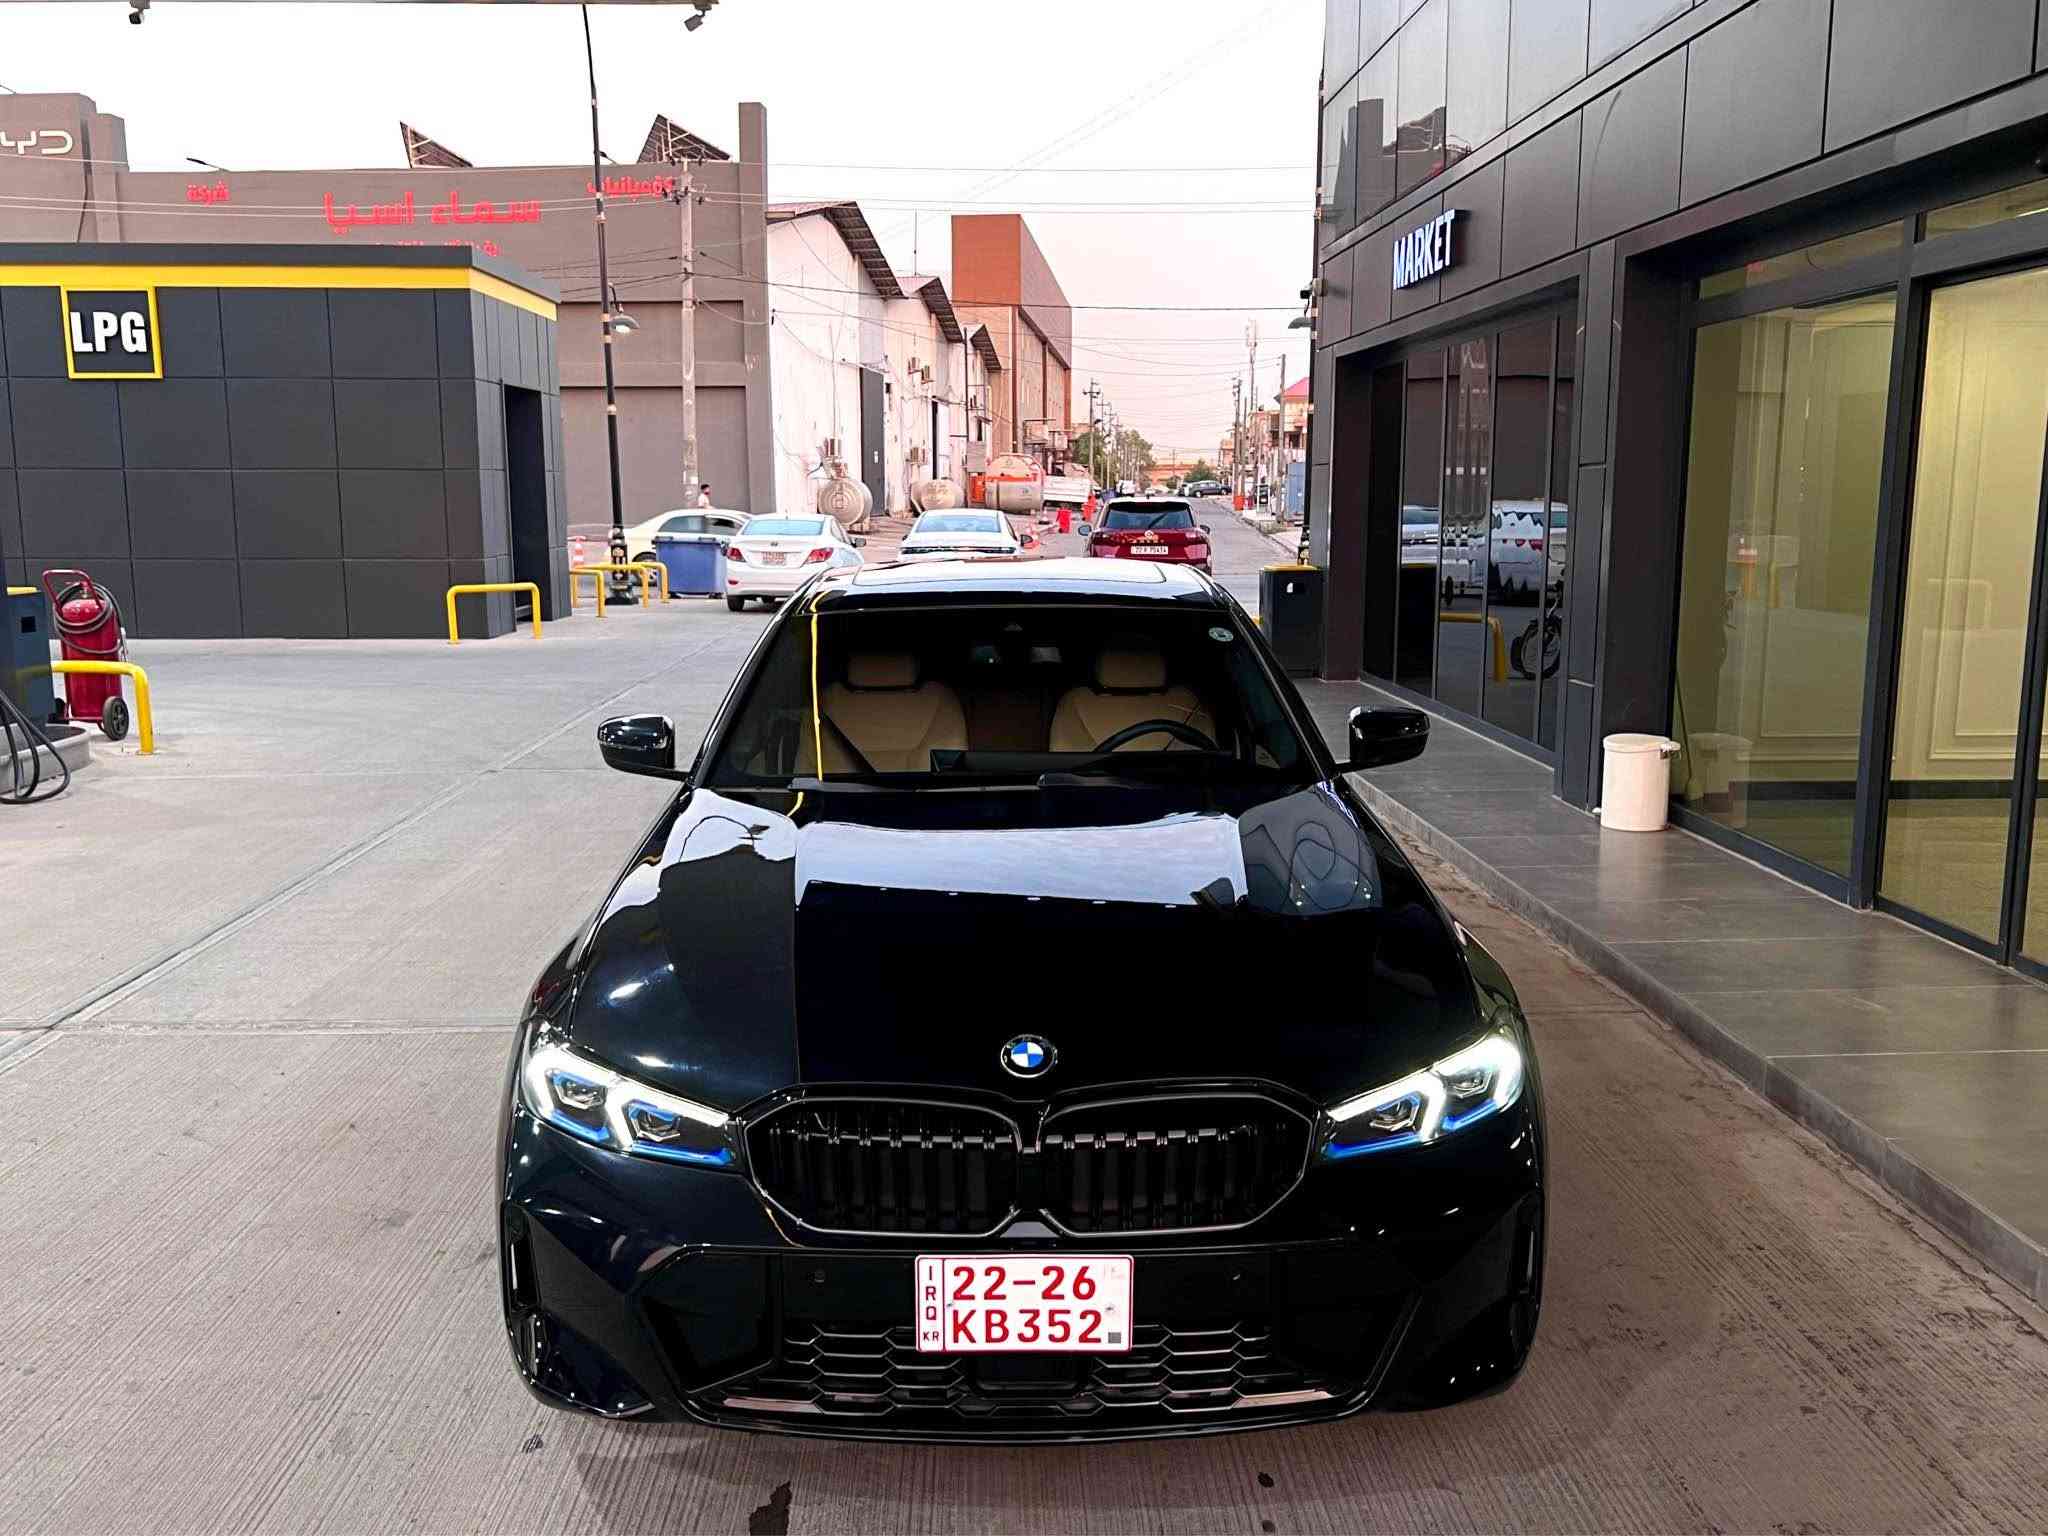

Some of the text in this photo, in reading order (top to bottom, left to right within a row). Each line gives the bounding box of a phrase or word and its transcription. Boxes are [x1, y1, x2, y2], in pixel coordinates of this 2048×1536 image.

[0, 130, 74, 155] YD
[1393, 209, 1455, 290] MARKET
[69, 311, 148, 353] LPG
[925, 1265, 937, 1321] IRQ
[953, 1265, 1096, 1301] 22-26
[922, 1331, 940, 1342] KR
[952, 1309, 1102, 1344] KB352
